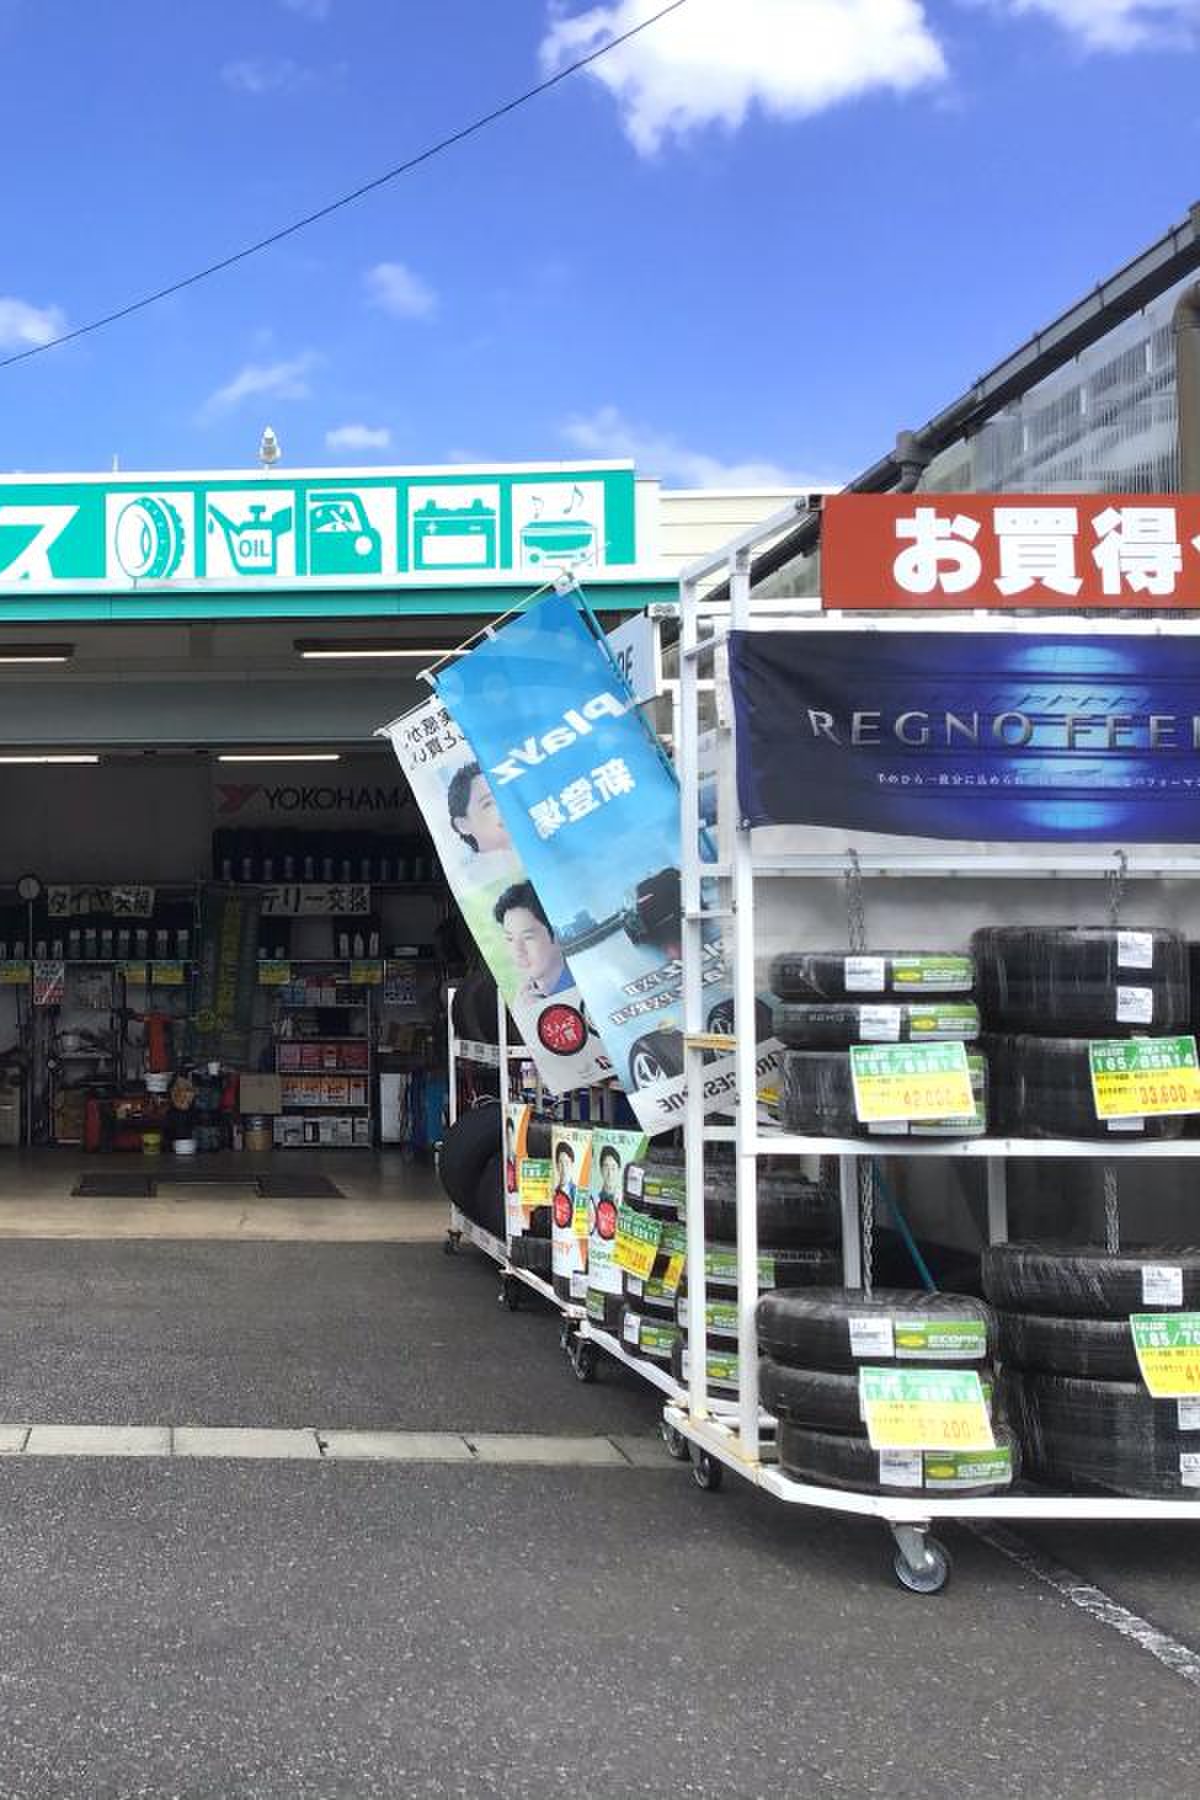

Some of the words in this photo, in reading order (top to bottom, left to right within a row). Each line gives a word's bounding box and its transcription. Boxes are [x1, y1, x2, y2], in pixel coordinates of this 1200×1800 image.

[238, 537, 271, 559] OIL
[894, 507, 1200, 596] お買得
[806, 709, 1035, 746] REGNO
[264, 786, 413, 810] YOKOHAMA
